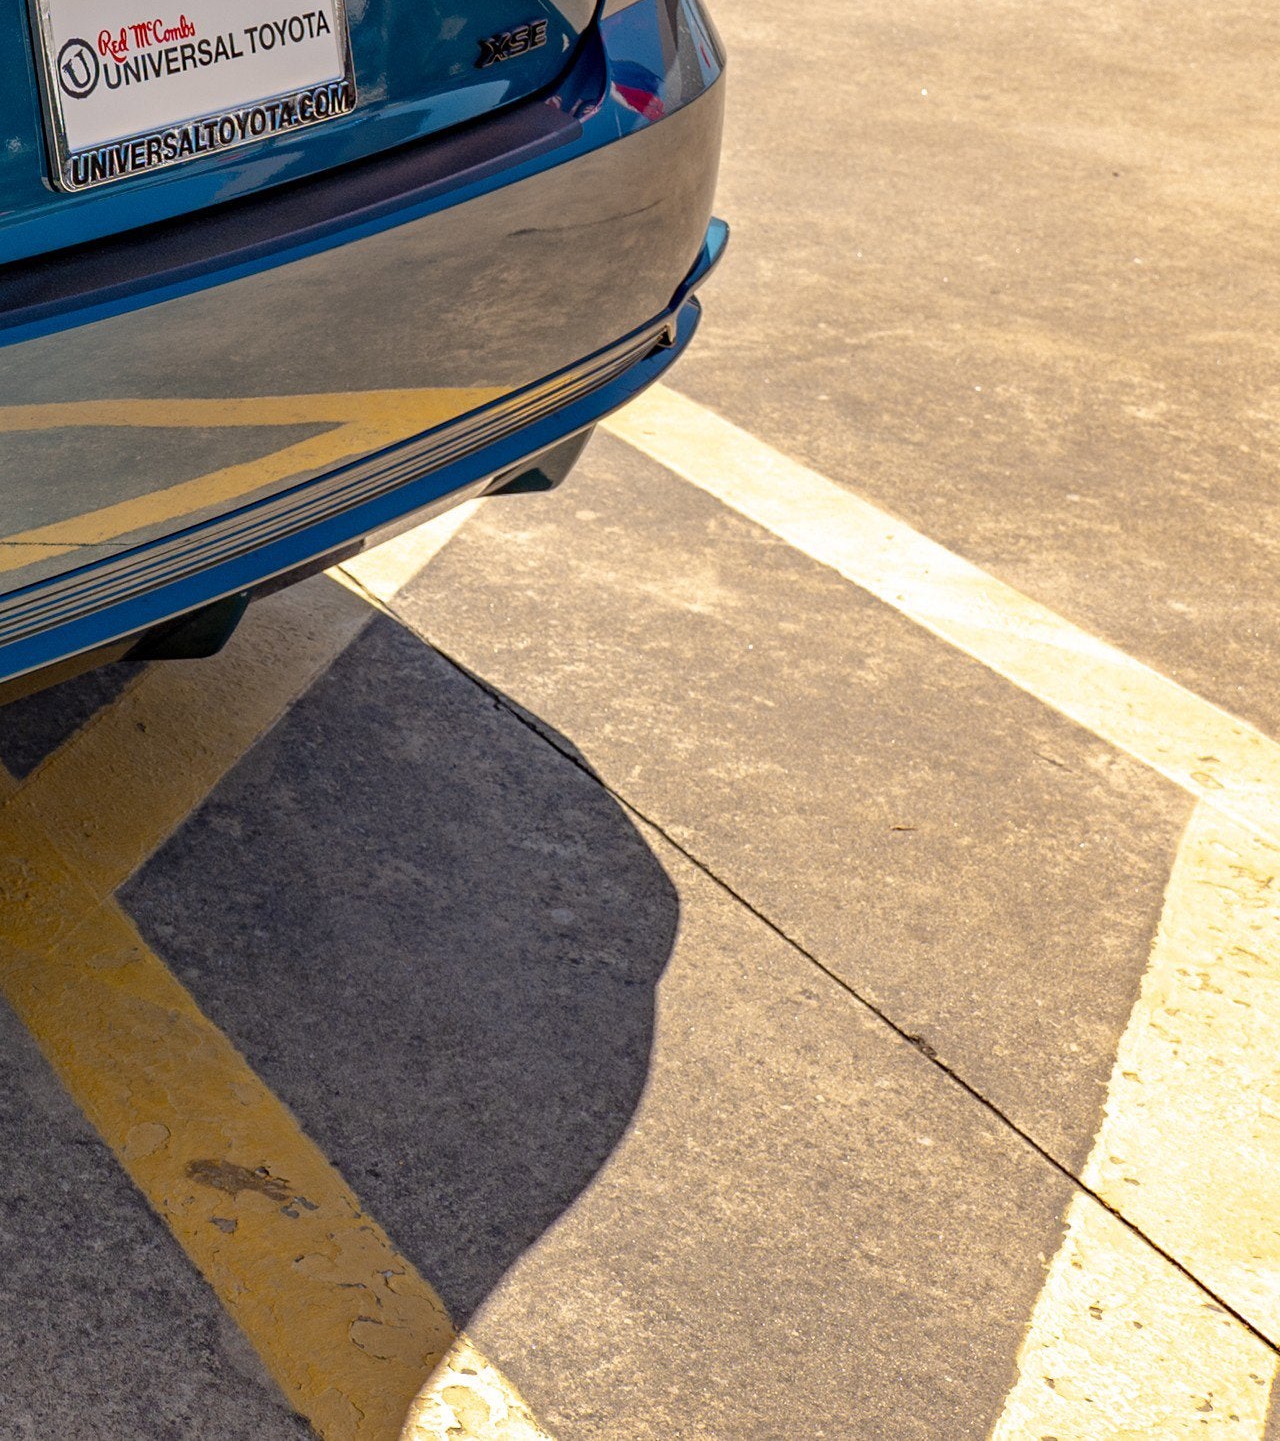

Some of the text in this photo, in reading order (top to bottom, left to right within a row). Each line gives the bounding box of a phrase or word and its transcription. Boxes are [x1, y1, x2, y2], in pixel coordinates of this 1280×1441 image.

[98, 14, 196, 64] Red McCombs
[103, 9, 331, 90] UNIVERSAL TOYOTA
[474, 18, 548, 69] XSE
[71, 81, 350, 188] UNIVERSALTOYOTA.COM
